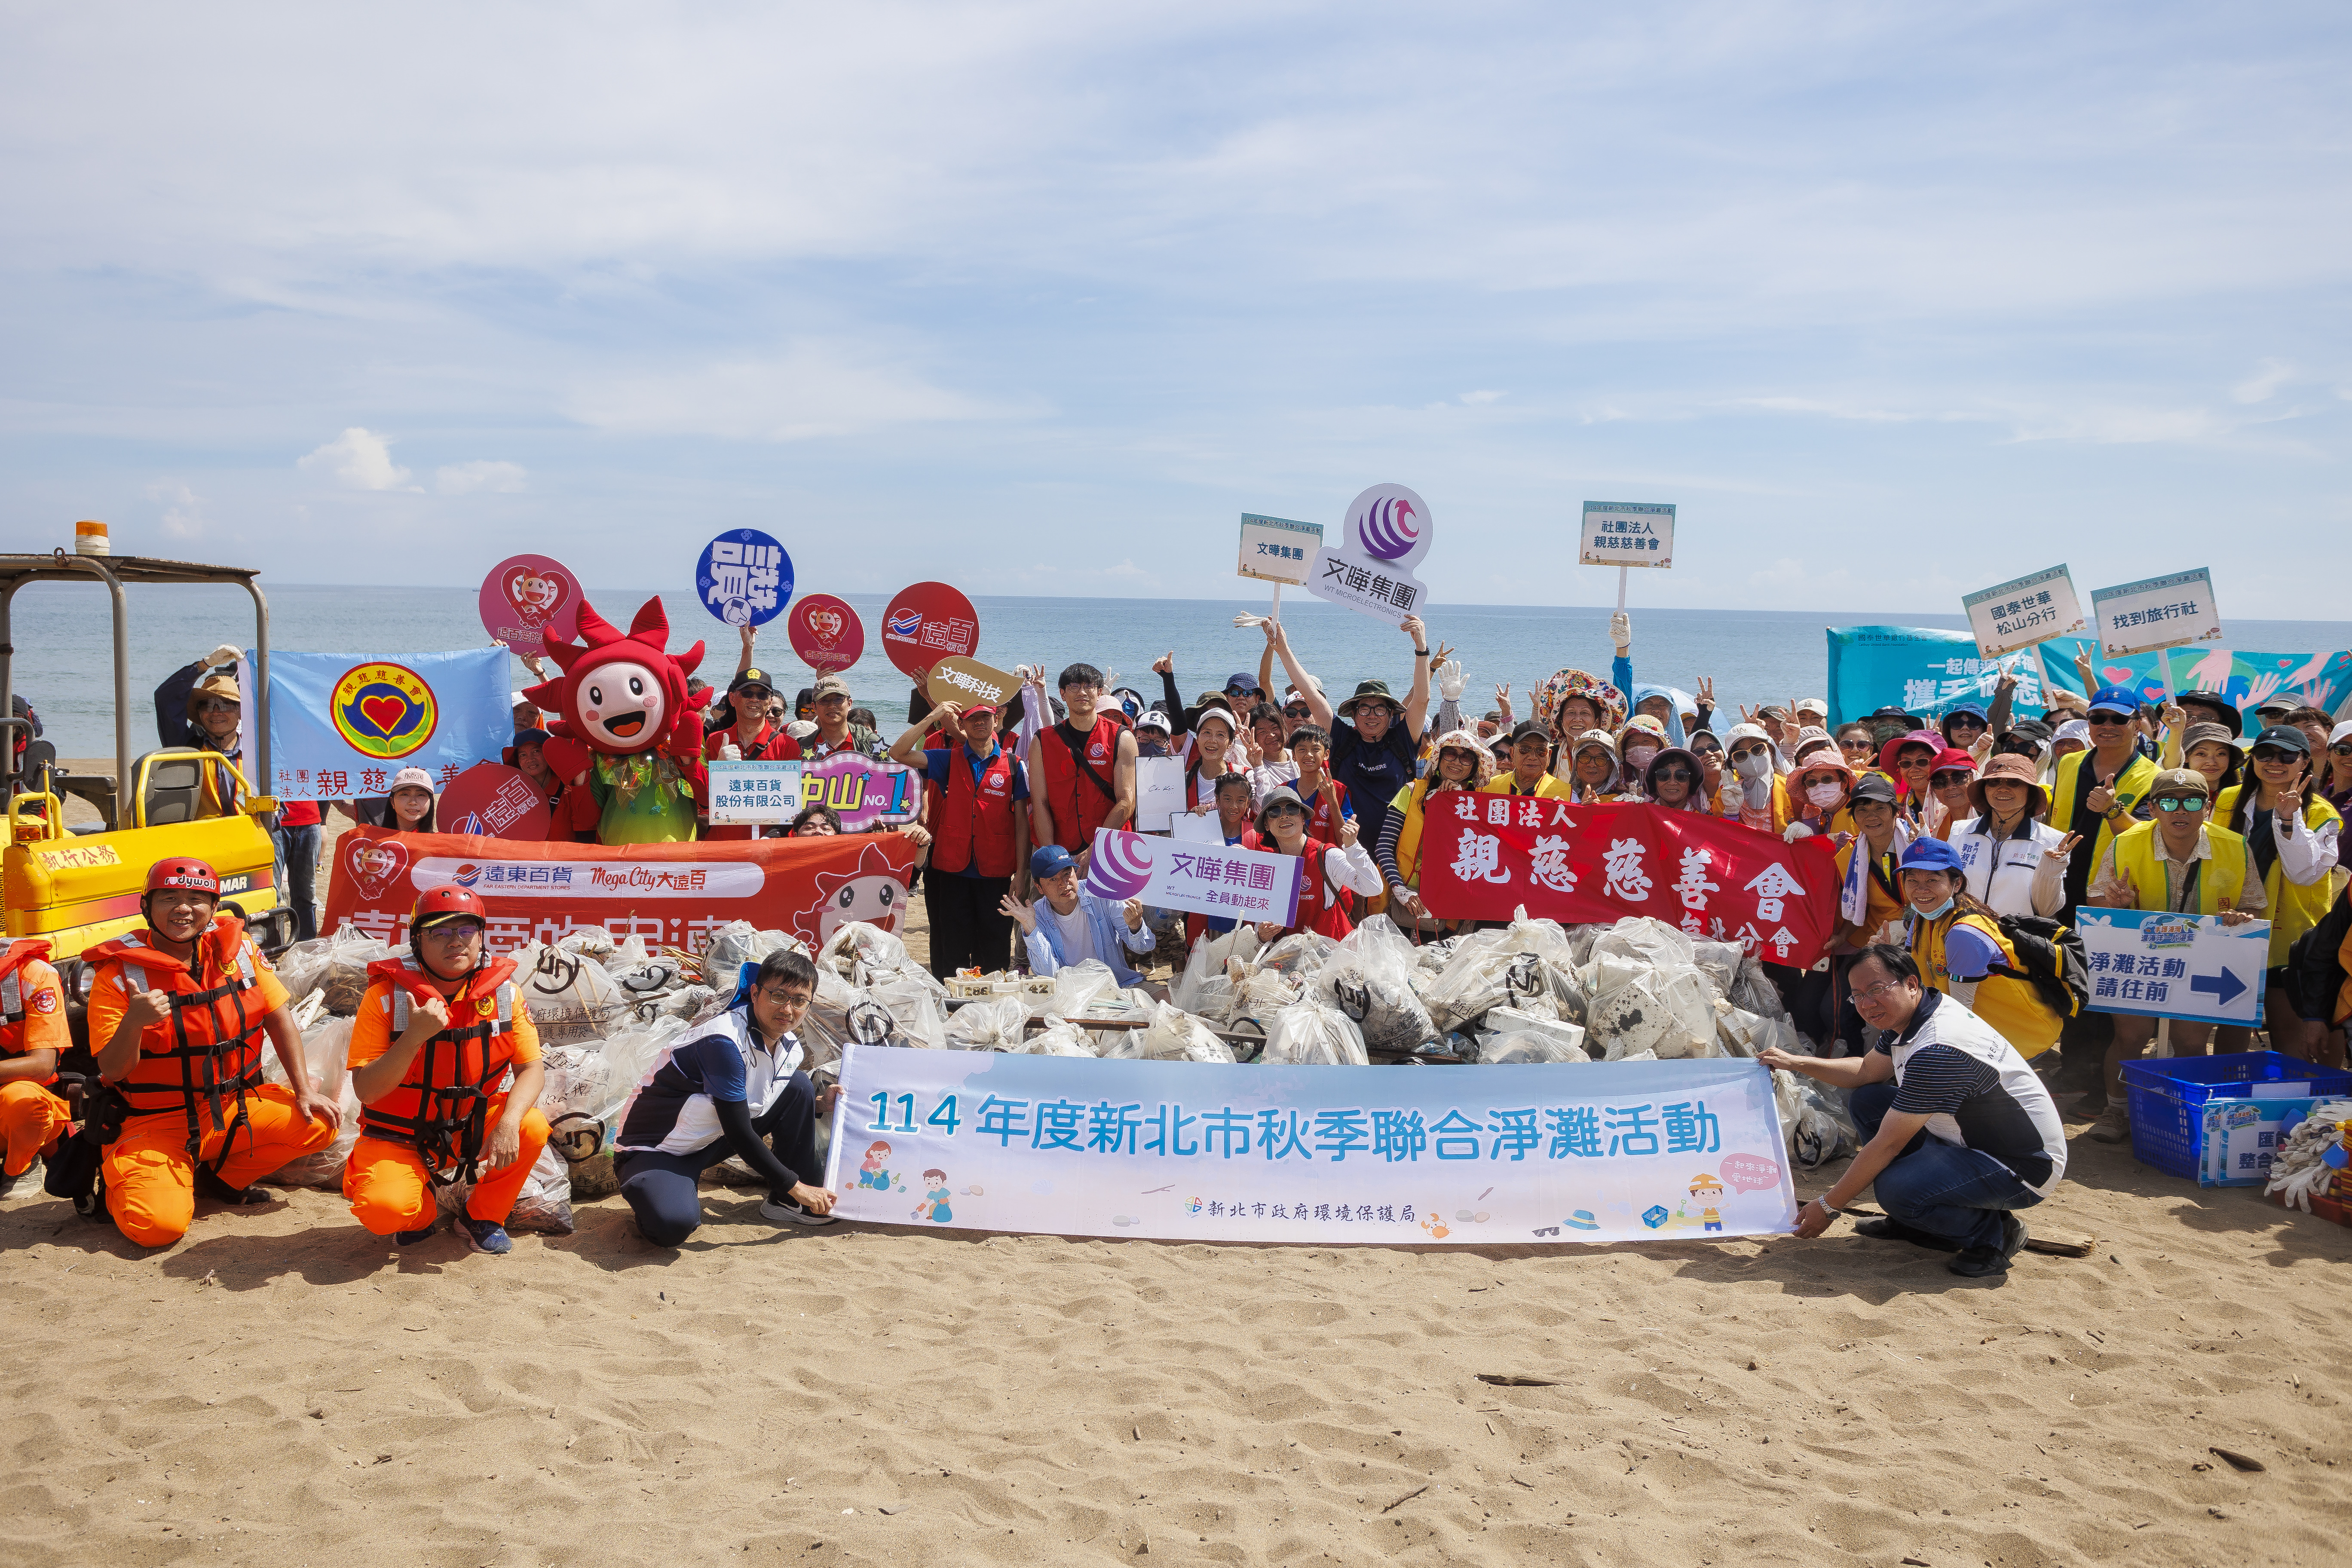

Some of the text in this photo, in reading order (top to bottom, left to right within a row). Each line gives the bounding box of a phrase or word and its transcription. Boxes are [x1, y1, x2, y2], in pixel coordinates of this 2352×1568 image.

[1601, 521, 1654, 535] 社團法人
[1257, 542, 1304, 561] 文曄集團
[1593, 535, 1660, 551] 親慈慈善會
[1321, 557, 1418, 612] 文曄集團
[1324, 584, 1402, 619] WT MICROELECTRONICS
[1990, 590, 2052, 621] 國泰世華
[1996, 606, 2056, 636] 松山分行
[2112, 600, 2199, 630] 找到旅行社
[497, 627, 562, 644] 遠百愛的
[896, 636, 918, 644] EASTERN
[920, 617, 974, 650] 遠百
[946, 642, 968, 654] 板橋
[343, 670, 422, 696] 親慈慈善會
[936, 666, 1003, 703] 文曄科技
[729, 779, 781, 792] 遠東百貨
[864, 793, 888, 806] NO.
[881, 769, 911, 815] 1
[482, 774, 533, 834] 遠百
[716, 795, 795, 808] 股份有限公司
[1455, 796, 1577, 829] 社團法人
[42, 844, 115, 869] 執行公務
[484, 865, 573, 883] 遠東百貨
[590, 866, 707, 892] Mega City 大遠百
[1170, 852, 1276, 891] 文曄集團
[1450, 827, 1806, 922] 親慈慈善會
[220, 876, 248, 893] MAR
[1166, 891, 1201, 900] MICROELECTRONICS
[1205, 889, 1271, 911] 全員動起來
[2088, 951, 2186, 979] 淨灘活動
[965, 986, 988, 996] 286
[1028, 984, 1048, 994] 42
[2095, 977, 2169, 1002] 請往前
[531, 1006, 611, 1021] 府環境保護局
[1987, 1041, 1999, 1060] NEW
[1724, 1160, 1778, 1174] 一起來淨灘
[1207, 1200, 1417, 1224] 新北市政府環境保護局
